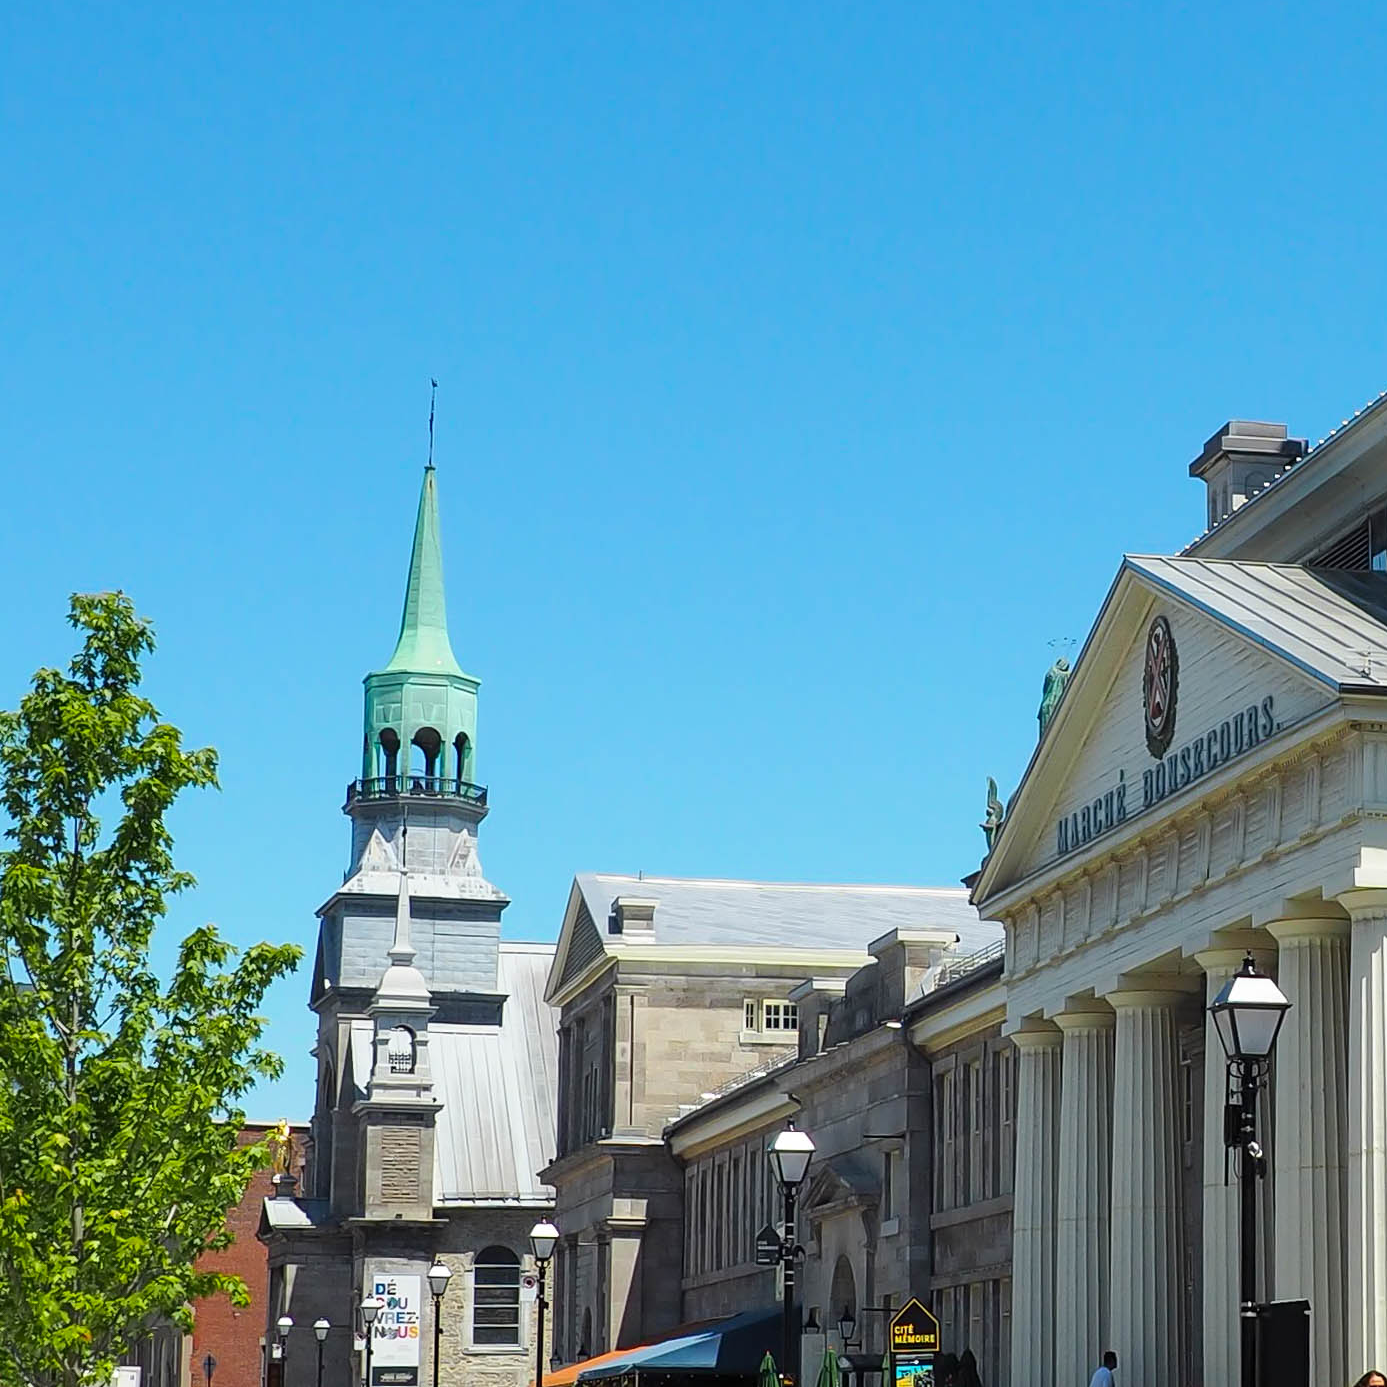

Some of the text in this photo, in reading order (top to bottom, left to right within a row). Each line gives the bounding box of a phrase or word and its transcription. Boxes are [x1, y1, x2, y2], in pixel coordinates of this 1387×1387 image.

[1057, 769, 1126, 855] MARCHÉ
[375, 1279, 397, 1295] DÉ
[374, 1325, 418, 1339] NOUS
[894, 1323, 915, 1334] CITÉ
[894, 1333, 936, 1344] MÉMOIRE
